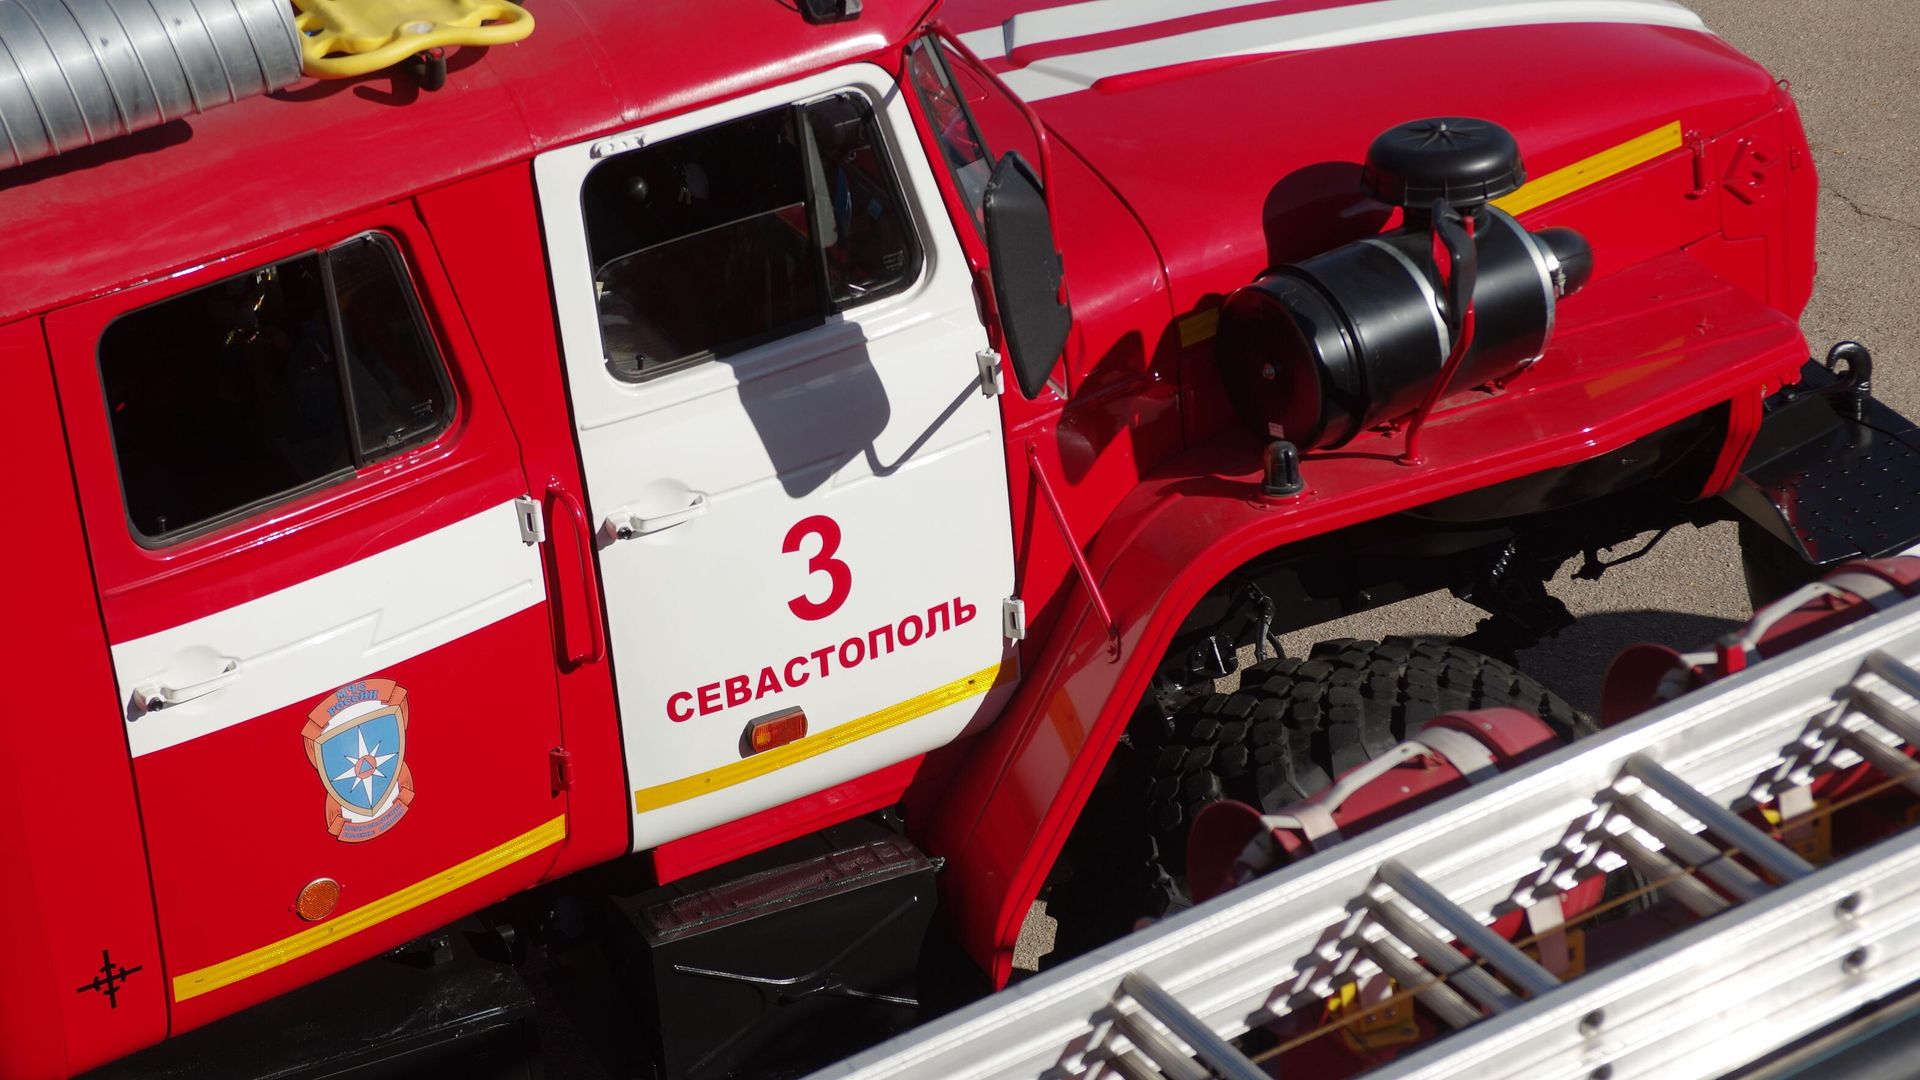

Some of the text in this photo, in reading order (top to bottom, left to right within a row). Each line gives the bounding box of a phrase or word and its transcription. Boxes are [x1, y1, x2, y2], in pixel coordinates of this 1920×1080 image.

[782, 515, 853, 622] 3
[336, 682, 366, 699] МЧС
[666, 596, 977, 723] СЕВАСТОПОЛЬ
[328, 690, 378, 717] РОССИИ
